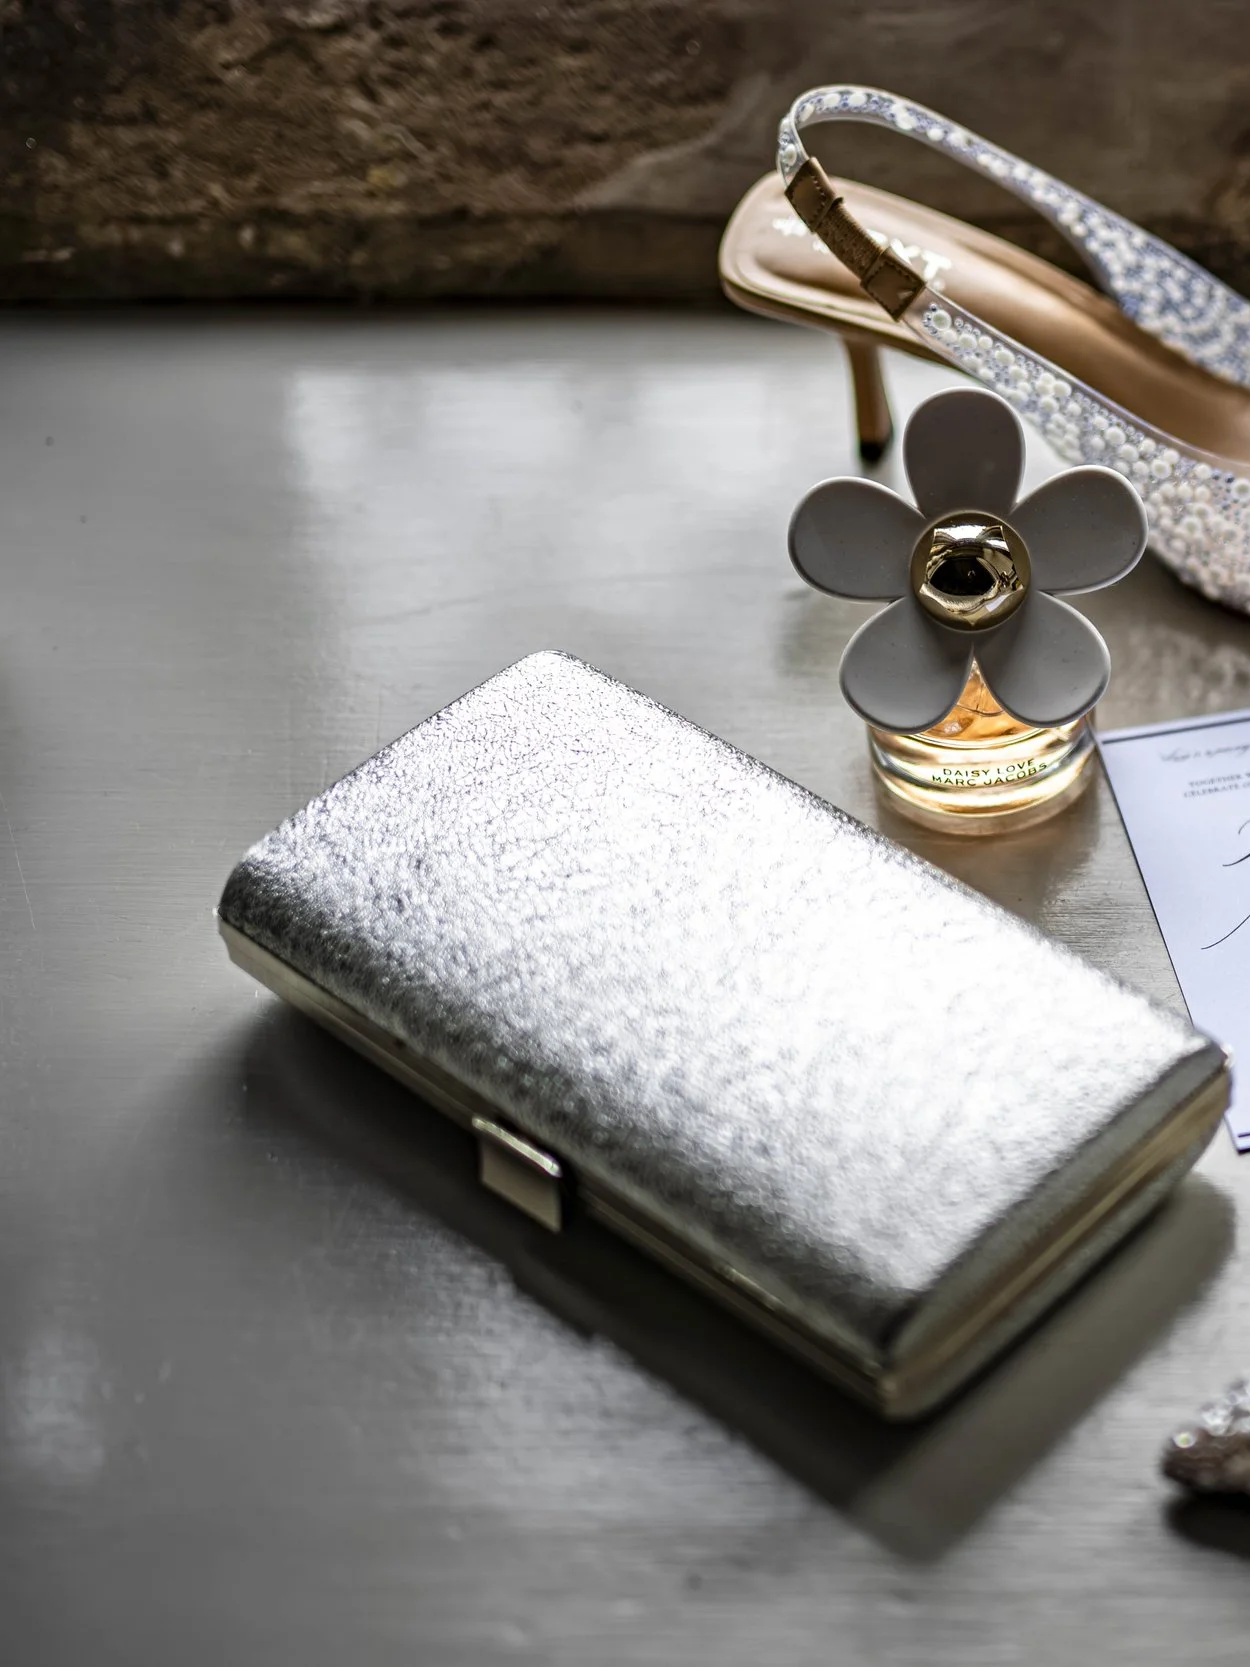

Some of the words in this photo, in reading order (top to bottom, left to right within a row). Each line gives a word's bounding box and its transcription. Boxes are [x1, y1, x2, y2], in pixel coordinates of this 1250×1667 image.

[932, 775, 977, 787] MARC
[983, 762, 1048, 786] JACOBS
[942, 767, 990, 778] DAISY
[997, 758, 1035, 775] LOVE
